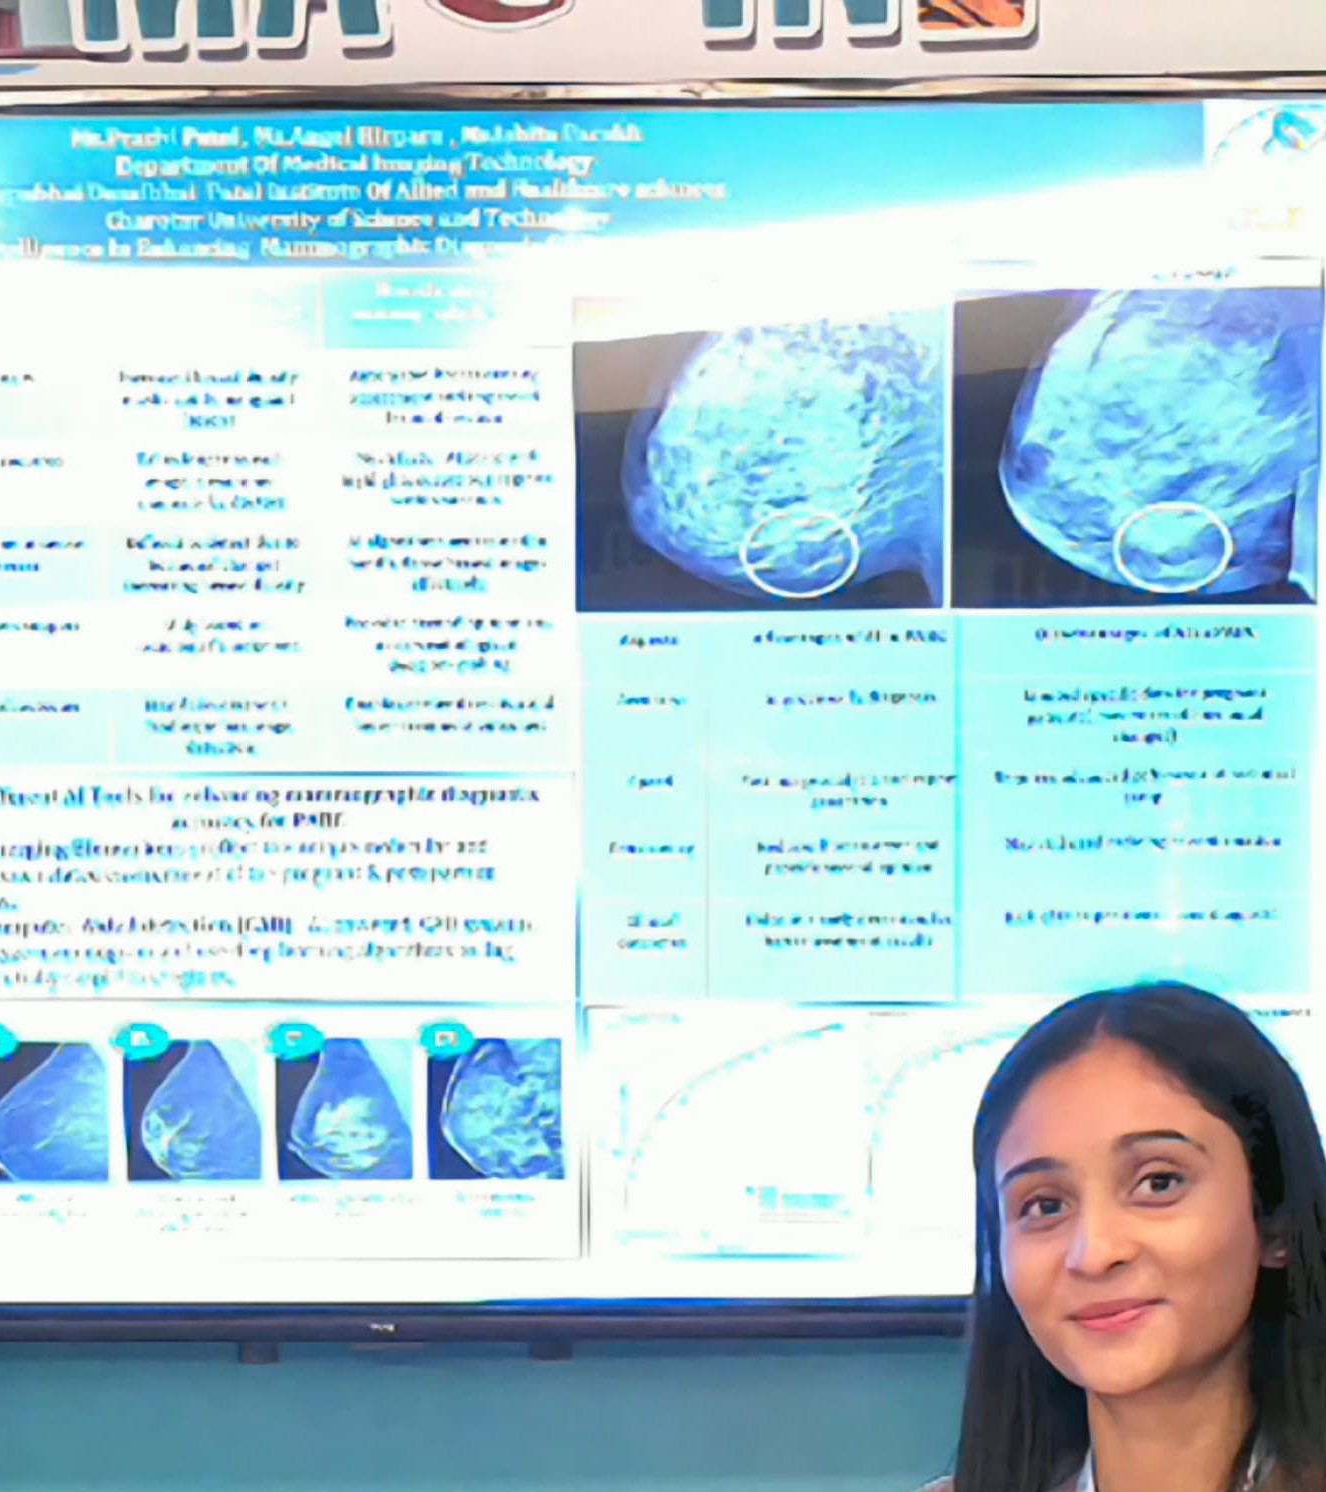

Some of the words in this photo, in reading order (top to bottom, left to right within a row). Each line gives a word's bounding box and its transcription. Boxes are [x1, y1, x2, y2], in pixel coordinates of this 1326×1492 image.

[115, 155, 251, 178] Department
[284, 153, 369, 173] Medical
[466, 151, 598, 179] Technology
